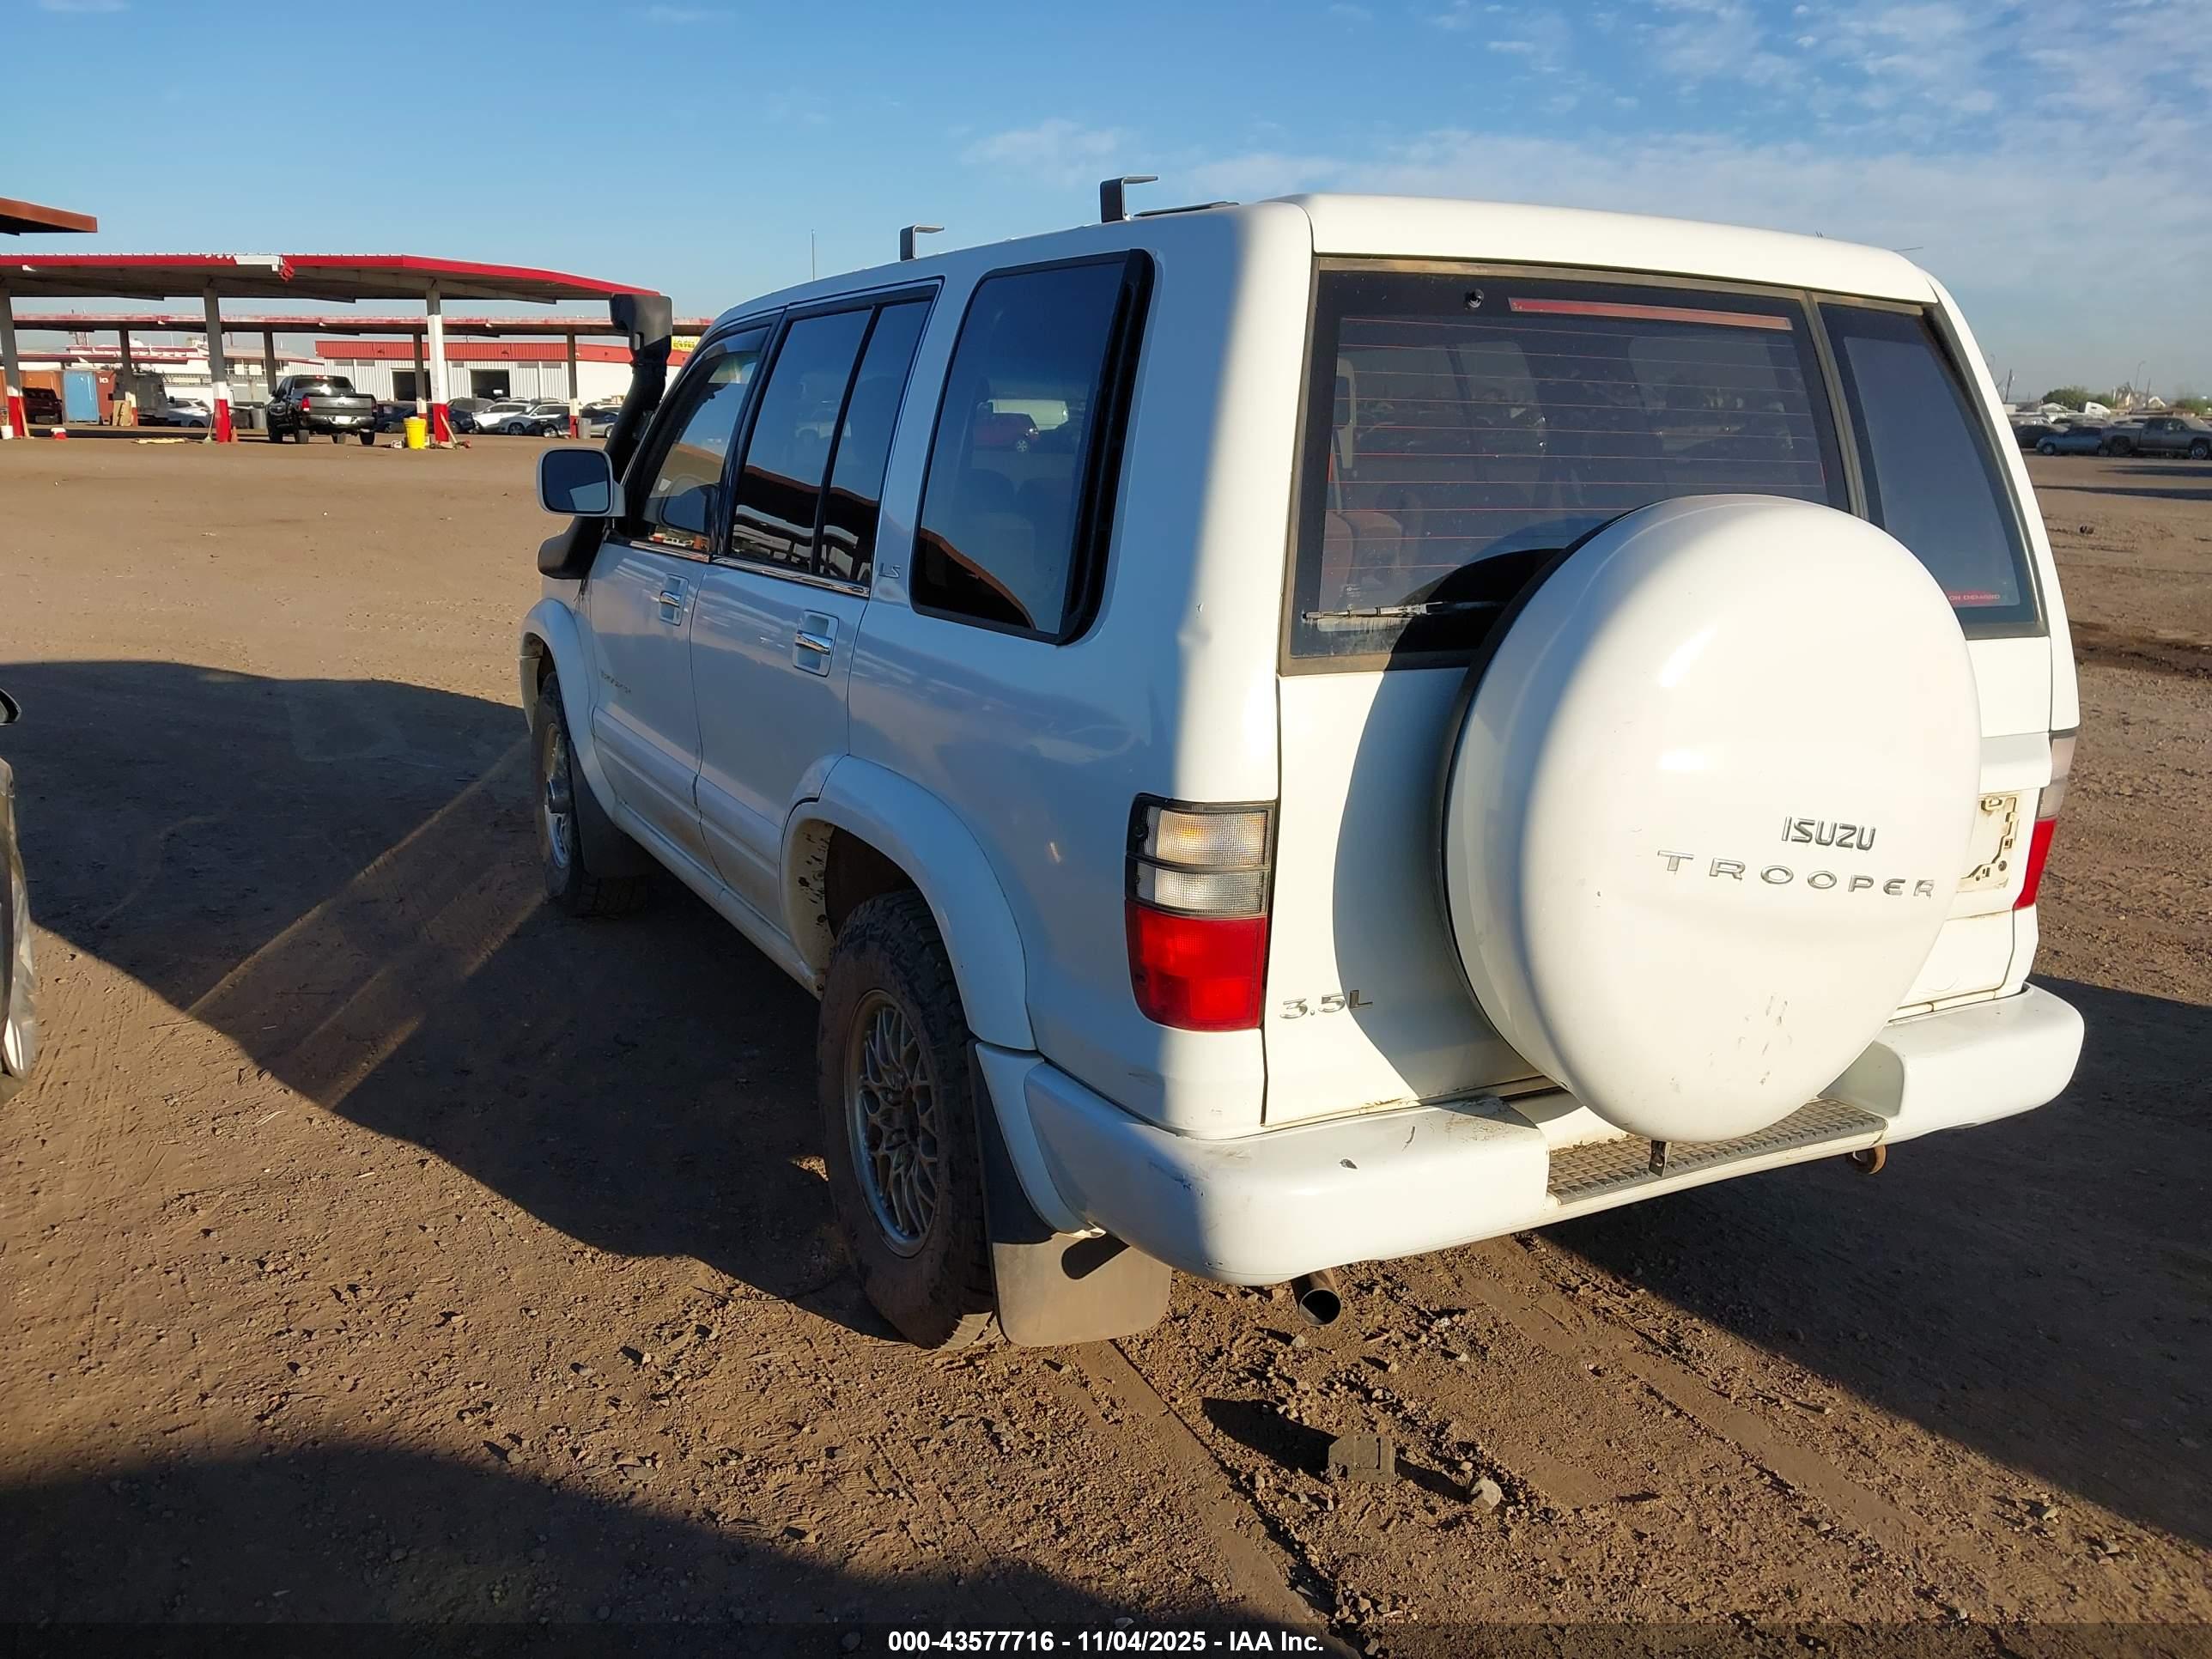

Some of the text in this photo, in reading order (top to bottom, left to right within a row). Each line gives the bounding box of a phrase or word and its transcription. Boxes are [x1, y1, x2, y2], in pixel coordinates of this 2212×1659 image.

[879, 562, 900, 579] LS
[1781, 816, 1876, 850] ISUZU
[1657, 850, 1934, 897] TROOPER
[1279, 989, 1373, 1019] 3.5L
